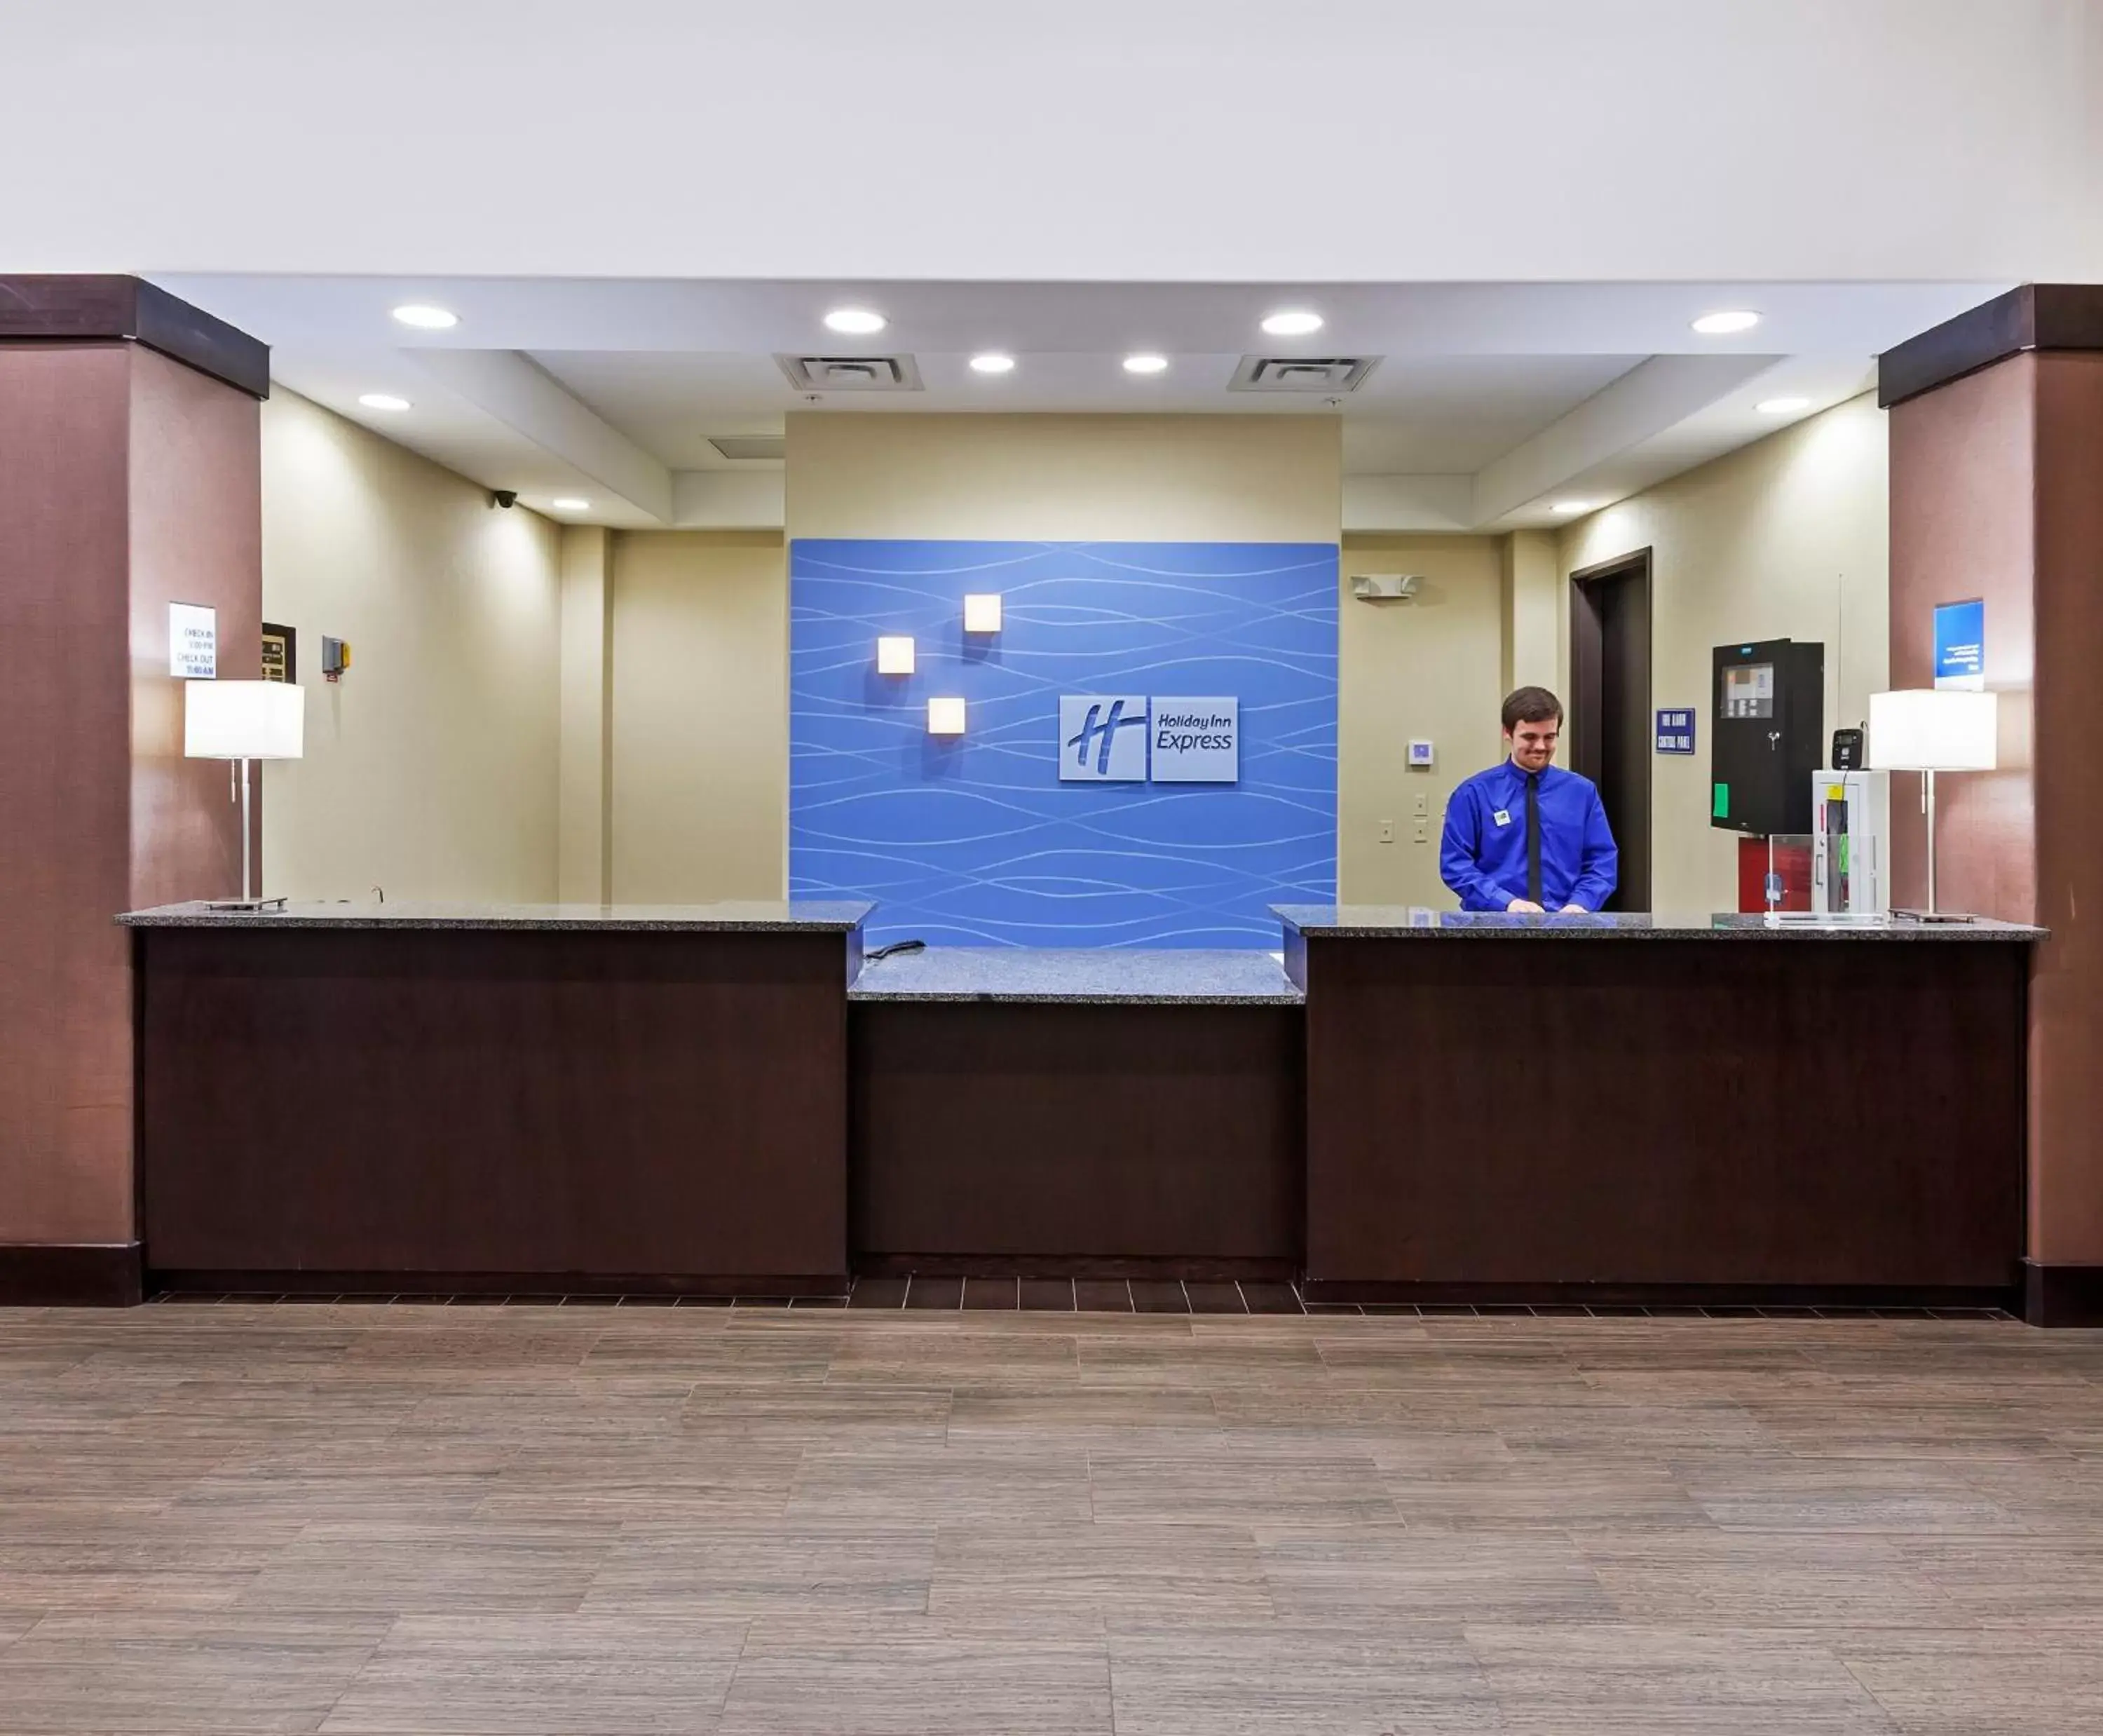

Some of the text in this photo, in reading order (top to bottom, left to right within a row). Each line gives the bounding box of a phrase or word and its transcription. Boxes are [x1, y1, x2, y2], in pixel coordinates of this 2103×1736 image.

[177, 653, 213, 664] CHECK OUT
[1158, 714, 1232, 730] Holiday Inn
[1157, 731, 1232, 754] Express
